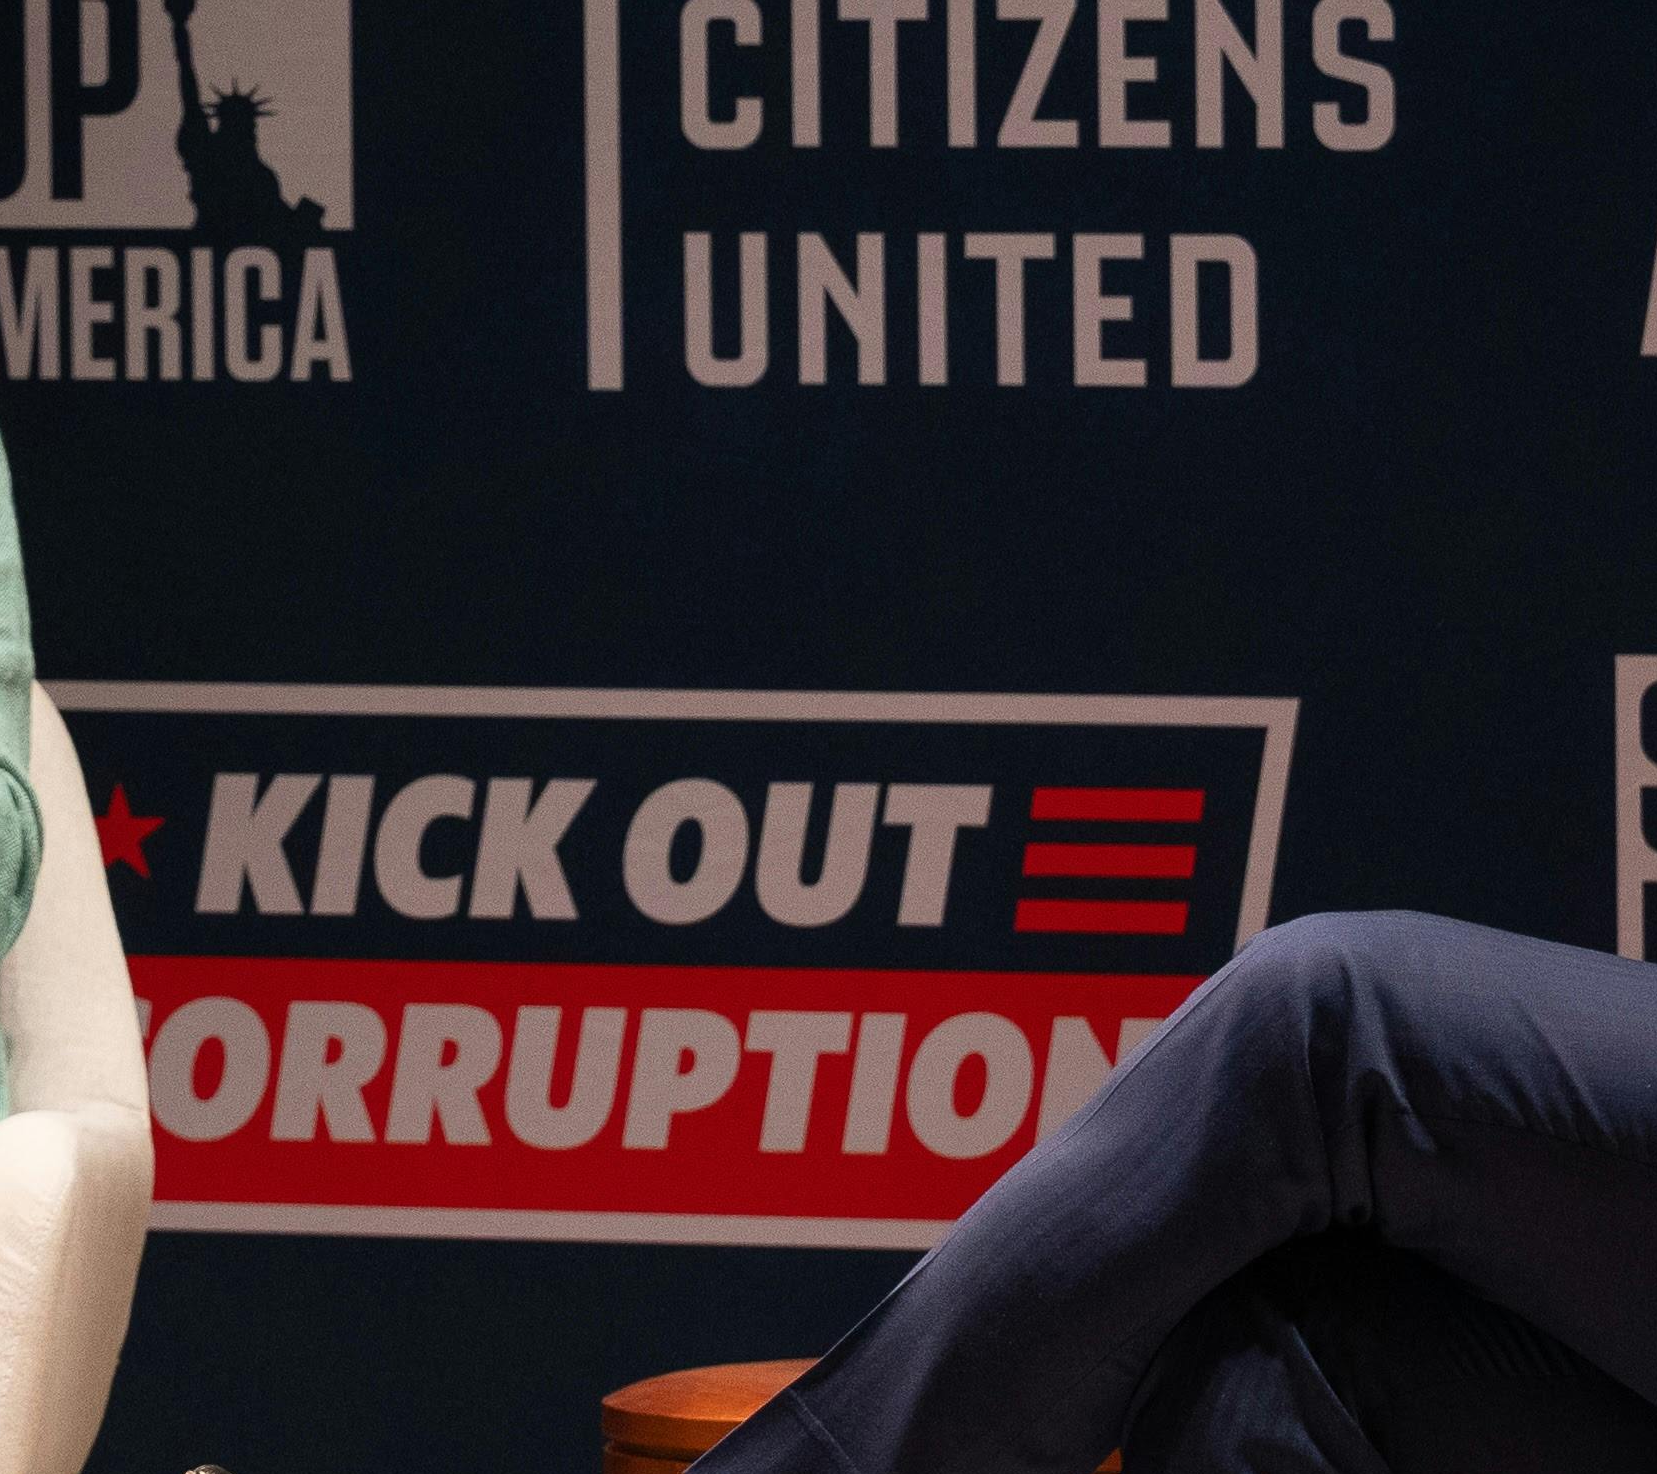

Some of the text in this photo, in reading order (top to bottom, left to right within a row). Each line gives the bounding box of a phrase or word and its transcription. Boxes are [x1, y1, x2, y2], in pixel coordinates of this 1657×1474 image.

[684, 232, 1259, 388] UNITED
[194, 773, 993, 927] KICK OUT
[135, 994, 1168, 1160] ORRUPTION
